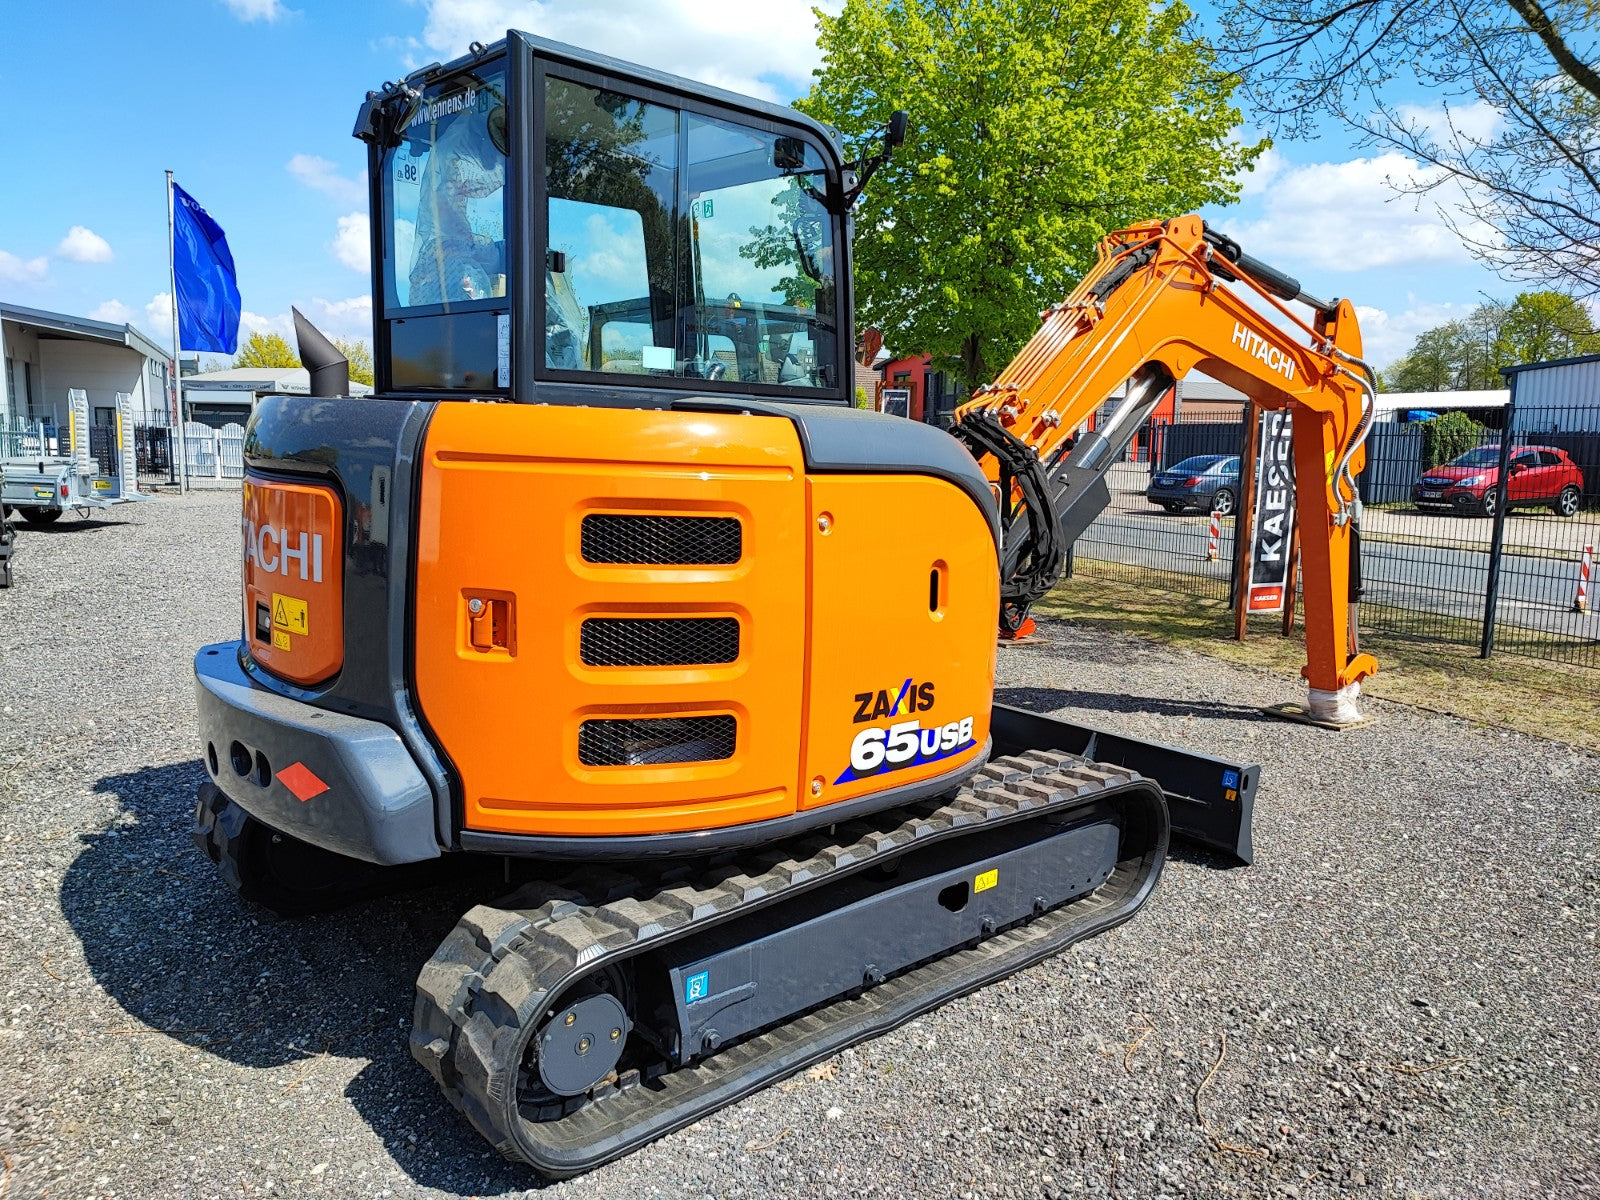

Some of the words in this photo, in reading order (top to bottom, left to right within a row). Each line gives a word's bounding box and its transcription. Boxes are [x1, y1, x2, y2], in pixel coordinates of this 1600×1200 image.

[411, 87, 476, 127] www.ennens.de
[1232, 321, 1295, 381] HITACHI
[1260, 413, 1292, 562] KAESER
[853, 678, 935, 724] ZAXIS
